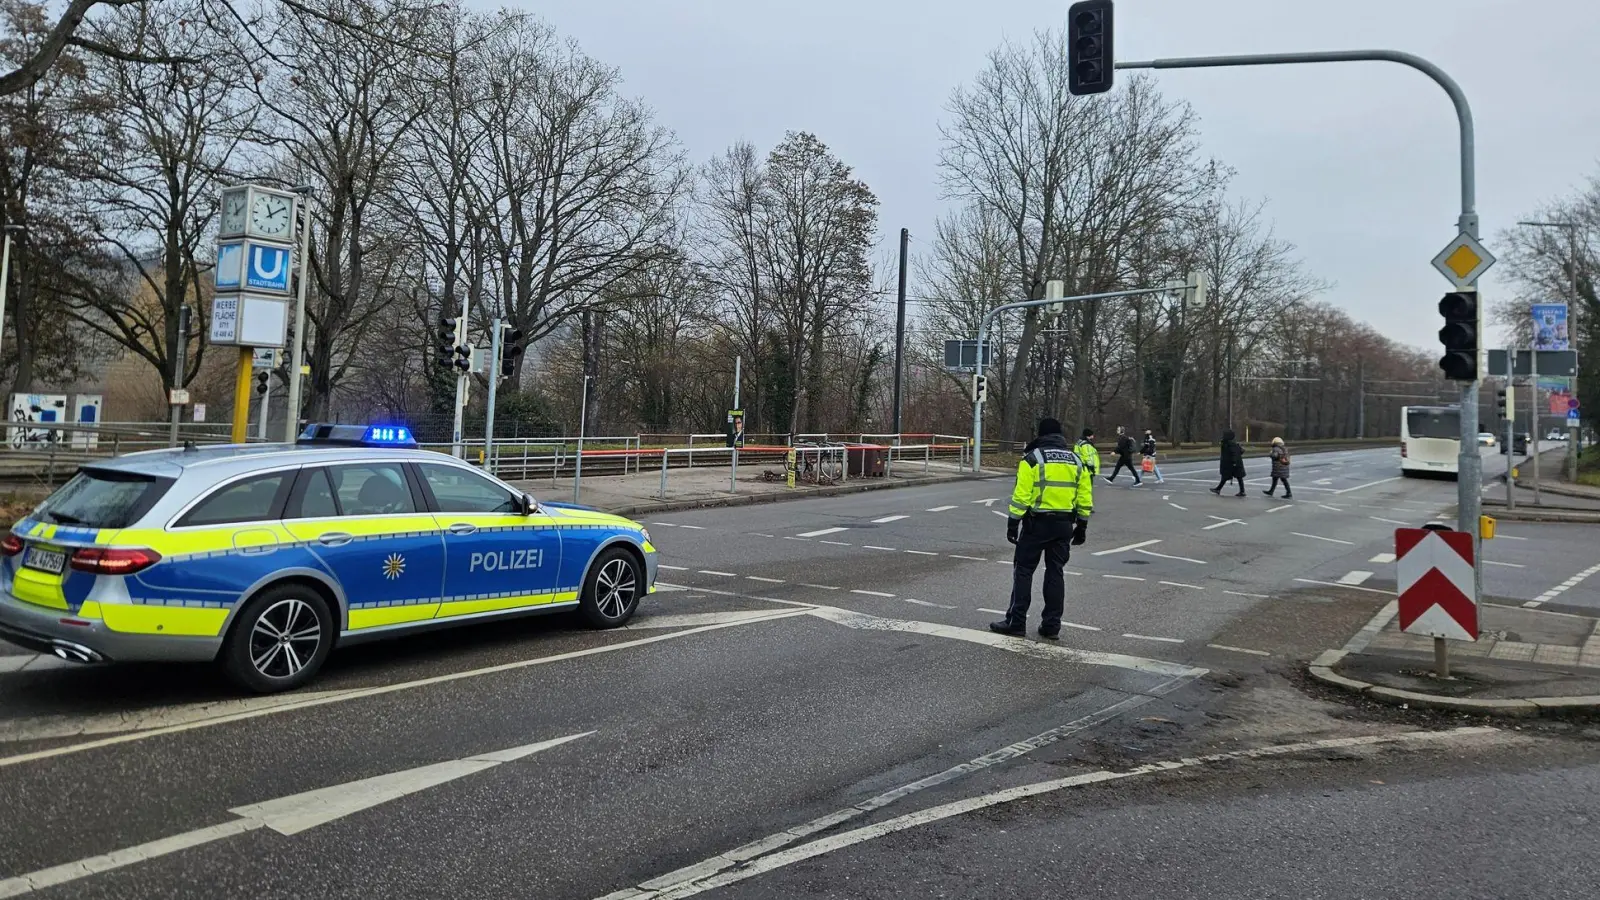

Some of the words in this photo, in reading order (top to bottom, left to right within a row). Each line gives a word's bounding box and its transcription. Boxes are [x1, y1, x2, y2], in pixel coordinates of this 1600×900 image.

[254, 247, 283, 280] U
[248, 278, 285, 289] STADTBAHN
[216, 300, 236, 309] WERBE
[215, 310, 236, 320] FLÄCHE
[1046, 452, 1073, 460] POLIZEI
[469, 548, 543, 573] POLIZEI
